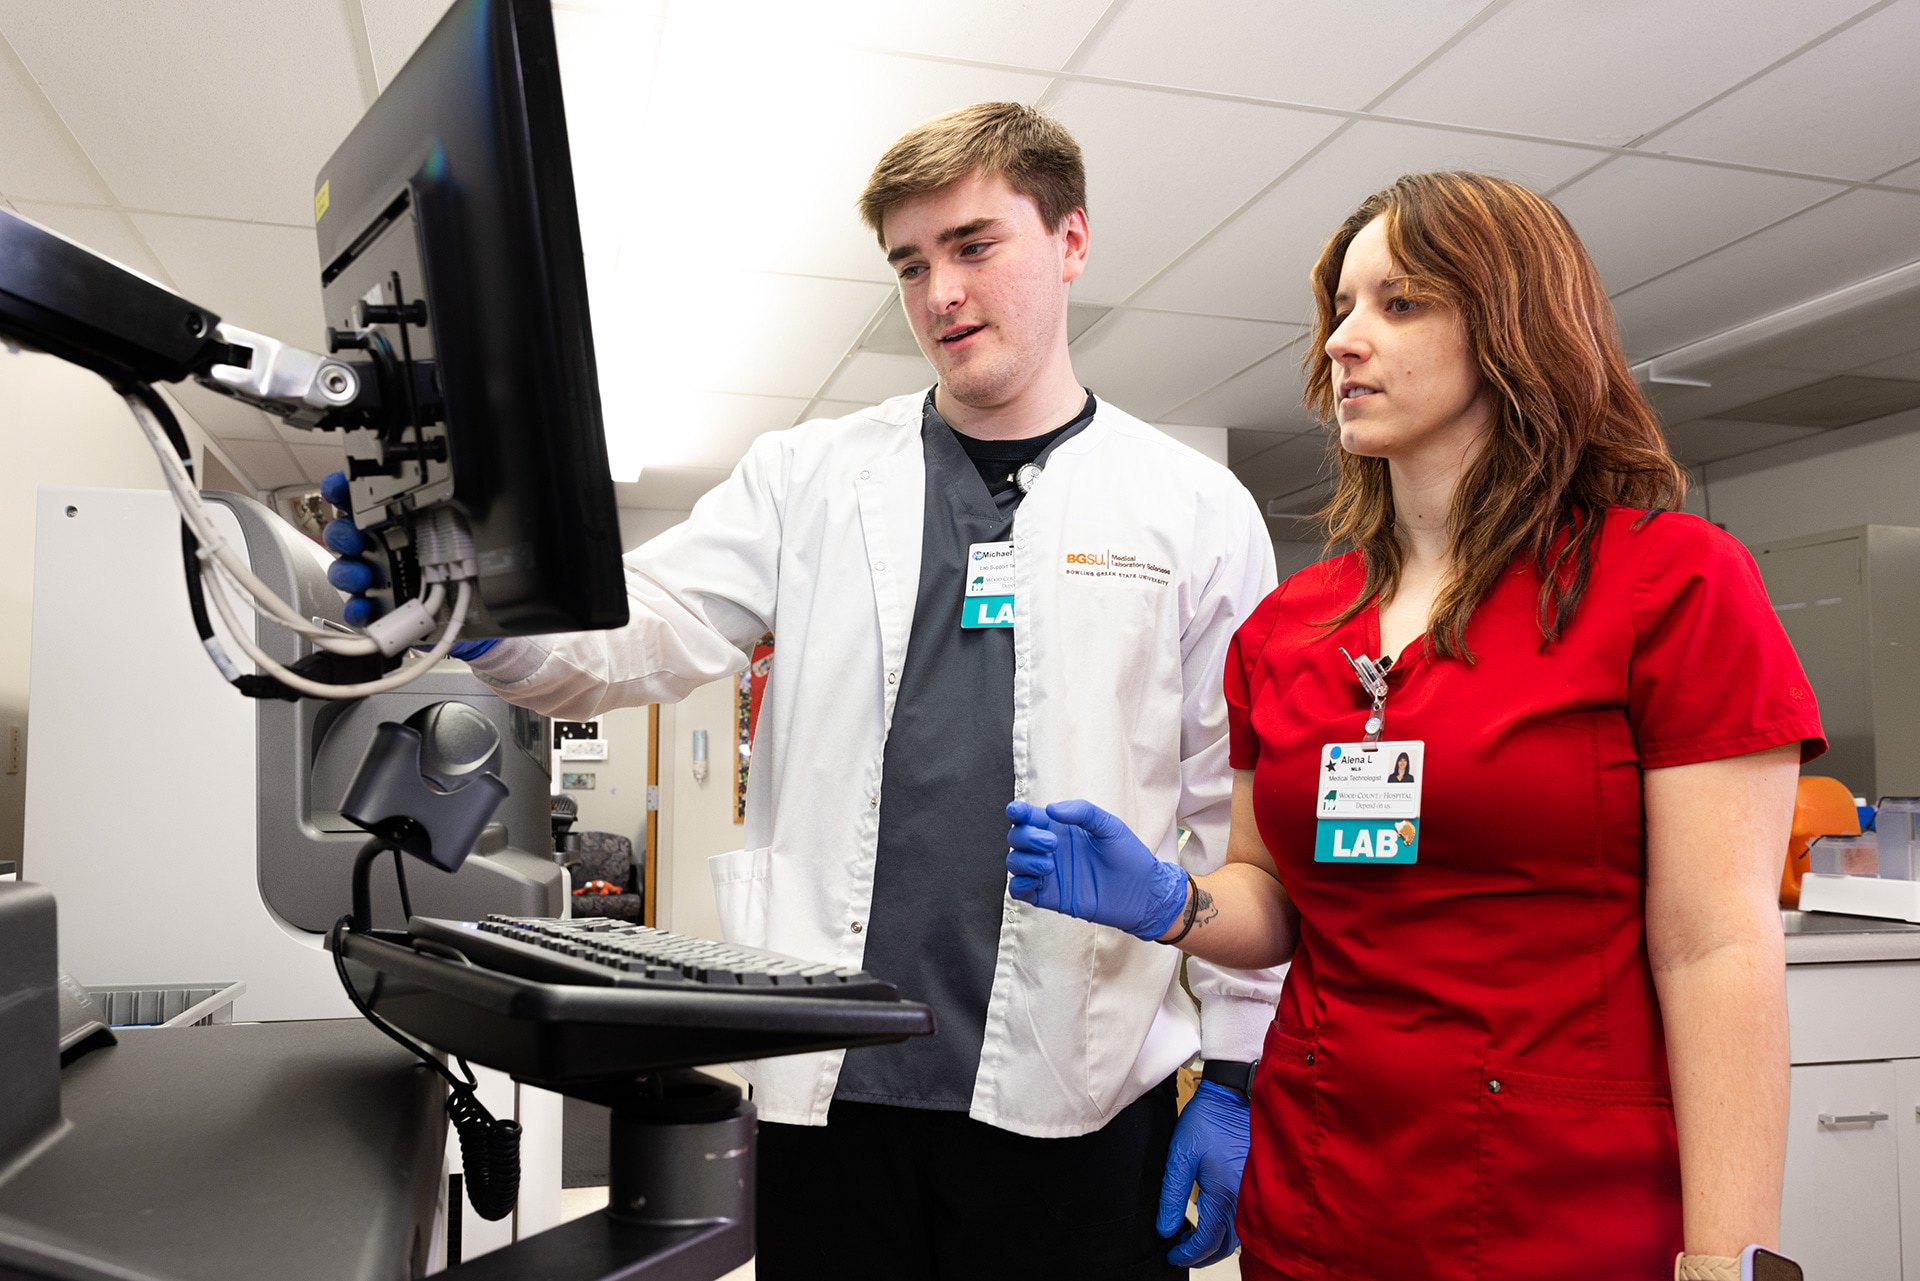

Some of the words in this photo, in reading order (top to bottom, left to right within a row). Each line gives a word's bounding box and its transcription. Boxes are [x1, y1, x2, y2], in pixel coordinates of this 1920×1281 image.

[983, 550, 1013, 558] Michael
[1111, 554, 1136, 562] Medical
[1111, 560, 1146, 570] Laboratory
[1066, 569, 1094, 577] BOWLING
[1139, 574, 1169, 586] UNIVERSITY
[1341, 756, 1365, 764] Alena
[1367, 755, 1373, 764] L
[1383, 791, 1412, 799] HOSPITAL
[1355, 802, 1376, 810] Depend
[1333, 829, 1398, 857] LAB
